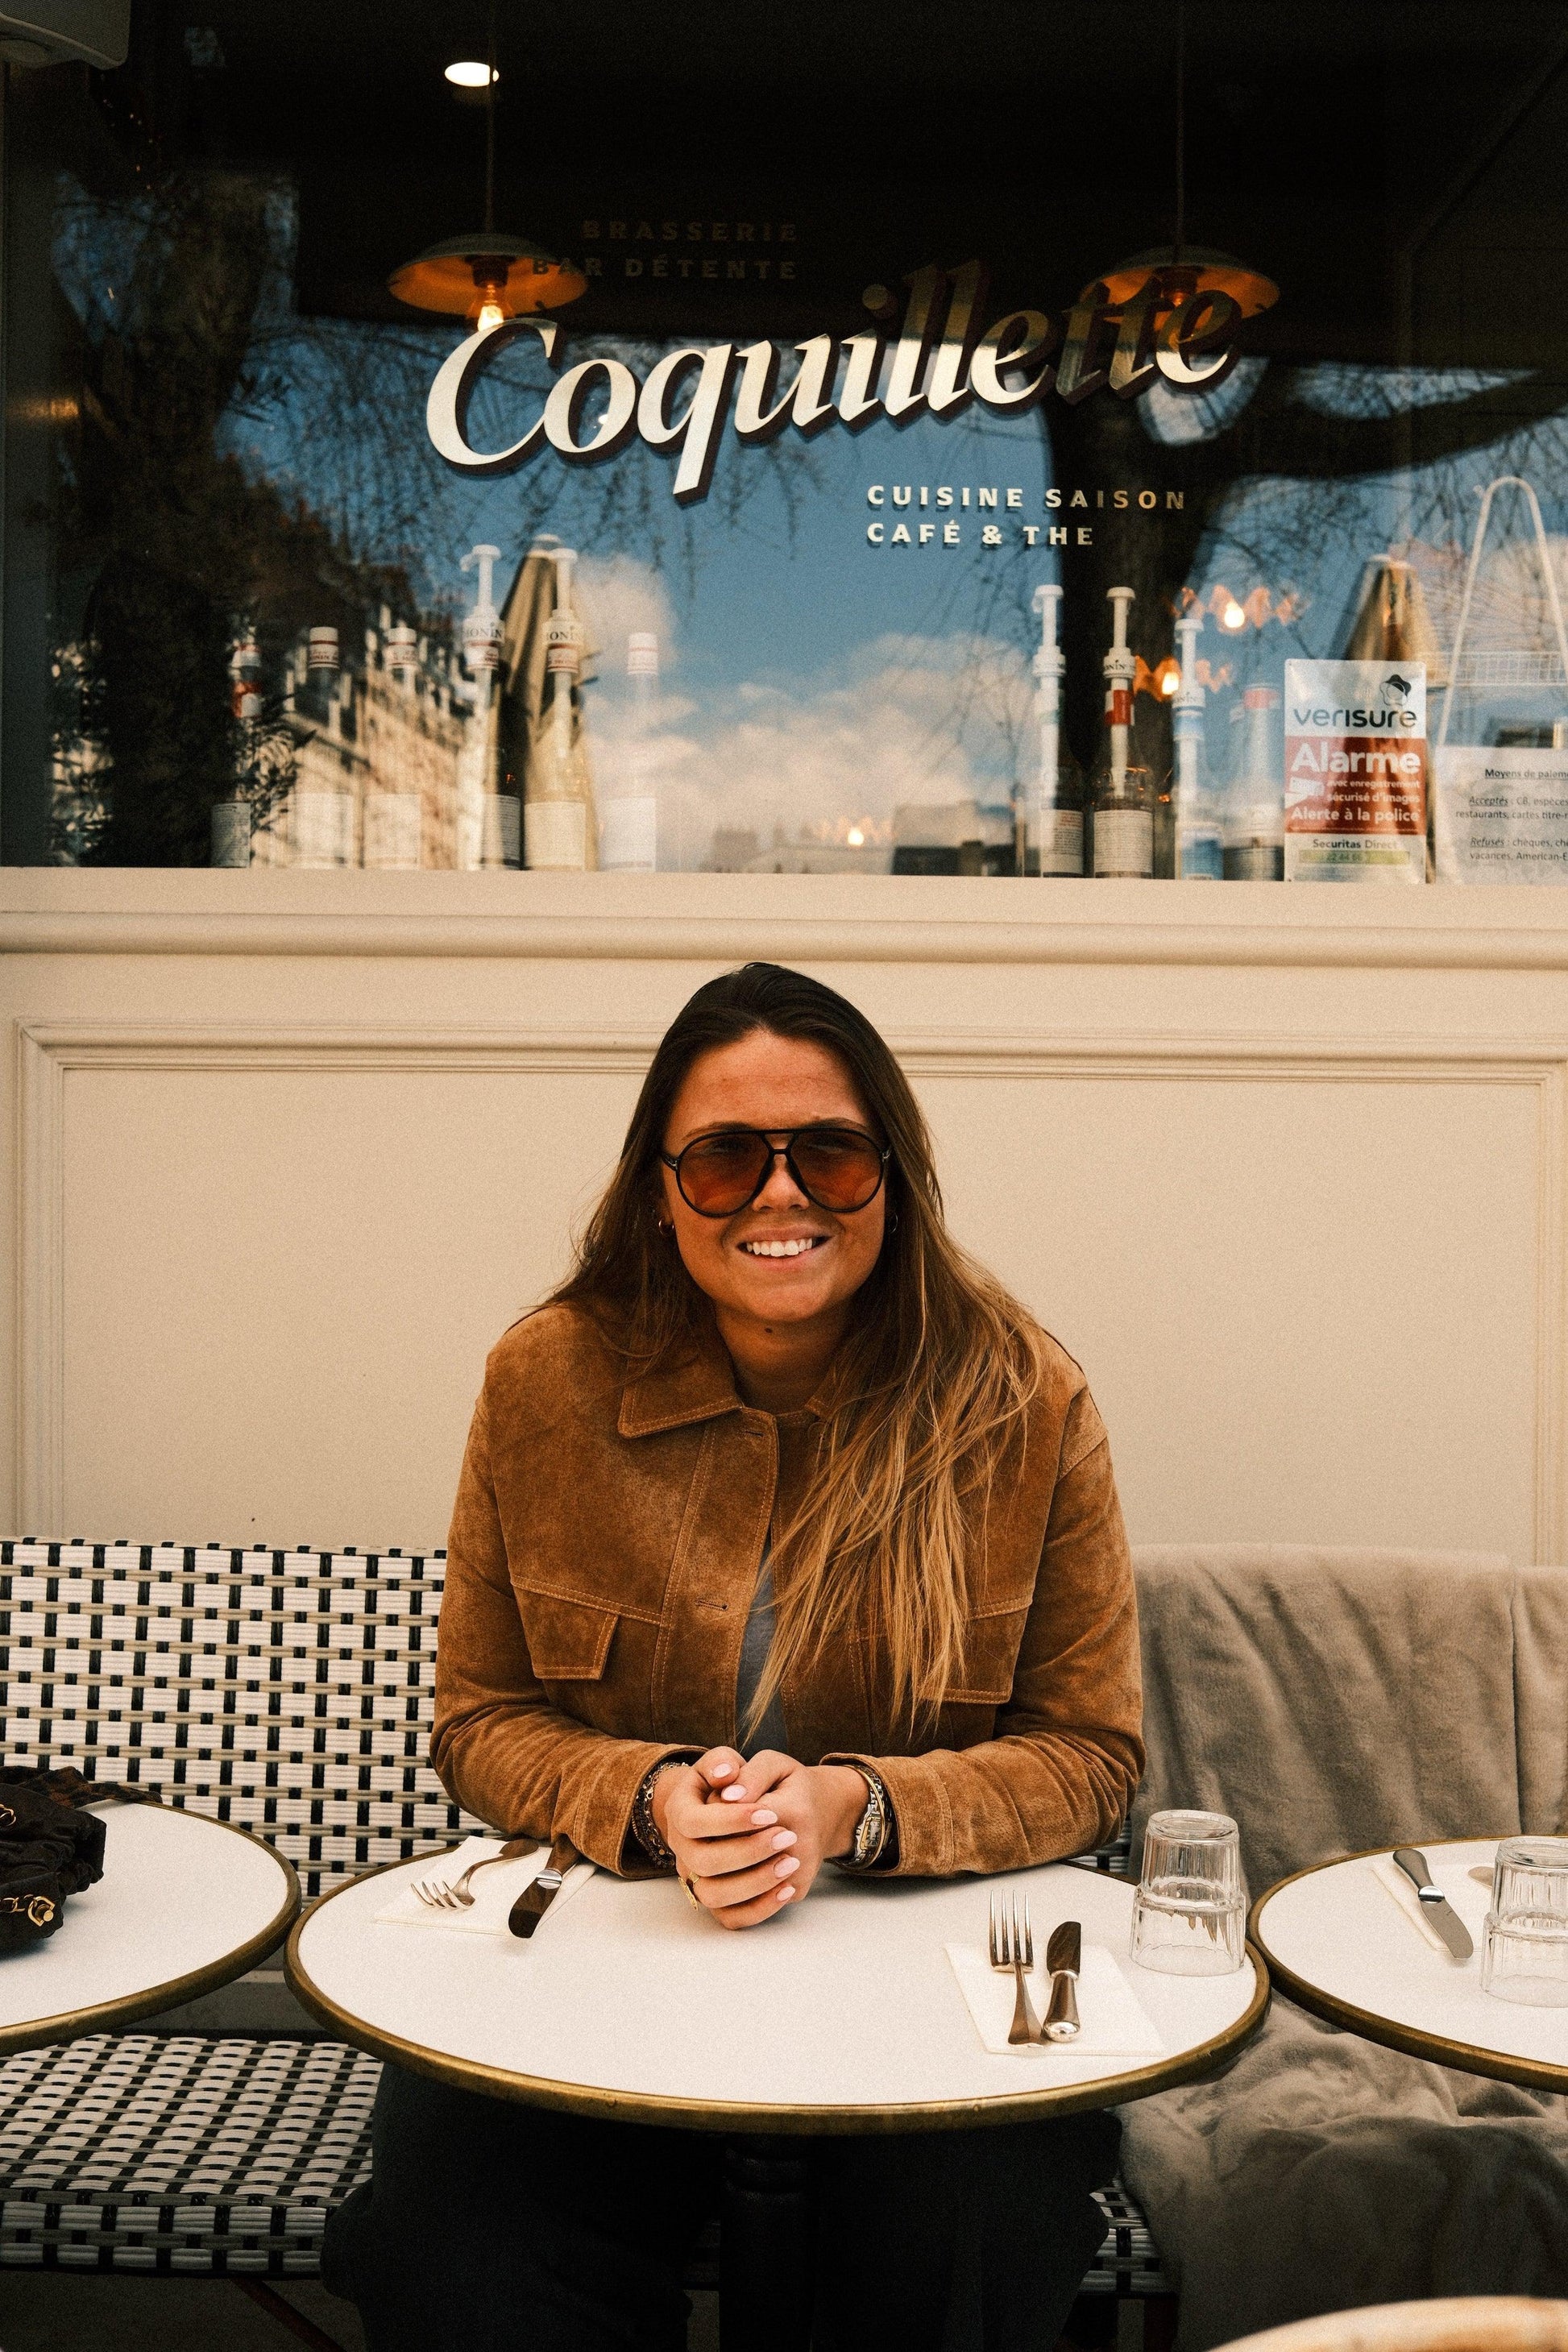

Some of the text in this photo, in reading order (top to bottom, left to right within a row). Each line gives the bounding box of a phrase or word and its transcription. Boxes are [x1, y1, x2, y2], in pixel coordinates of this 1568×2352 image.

[583, 220, 797, 243] BRASSERIE
[532, 253, 797, 280] BAR DÉTENTE
[425, 259, 1239, 501] Coquillette
[867, 485, 1184, 509] CUISINE SAISON
[867, 519, 1093, 545] CAFÉ & THE
[1293, 709, 1417, 728] verisure
[1291, 741, 1421, 774] Alarme
[1484, 769, 1521, 779] Moyens
[1524, 769, 1536, 778] de
[1327, 792, 1370, 802] sécurisé
[1291, 807, 1339, 821] Alerte
[1344, 807, 1354, 821] à
[1358, 807, 1371, 821] la
[1313, 839, 1397, 848] Securitas Direct
